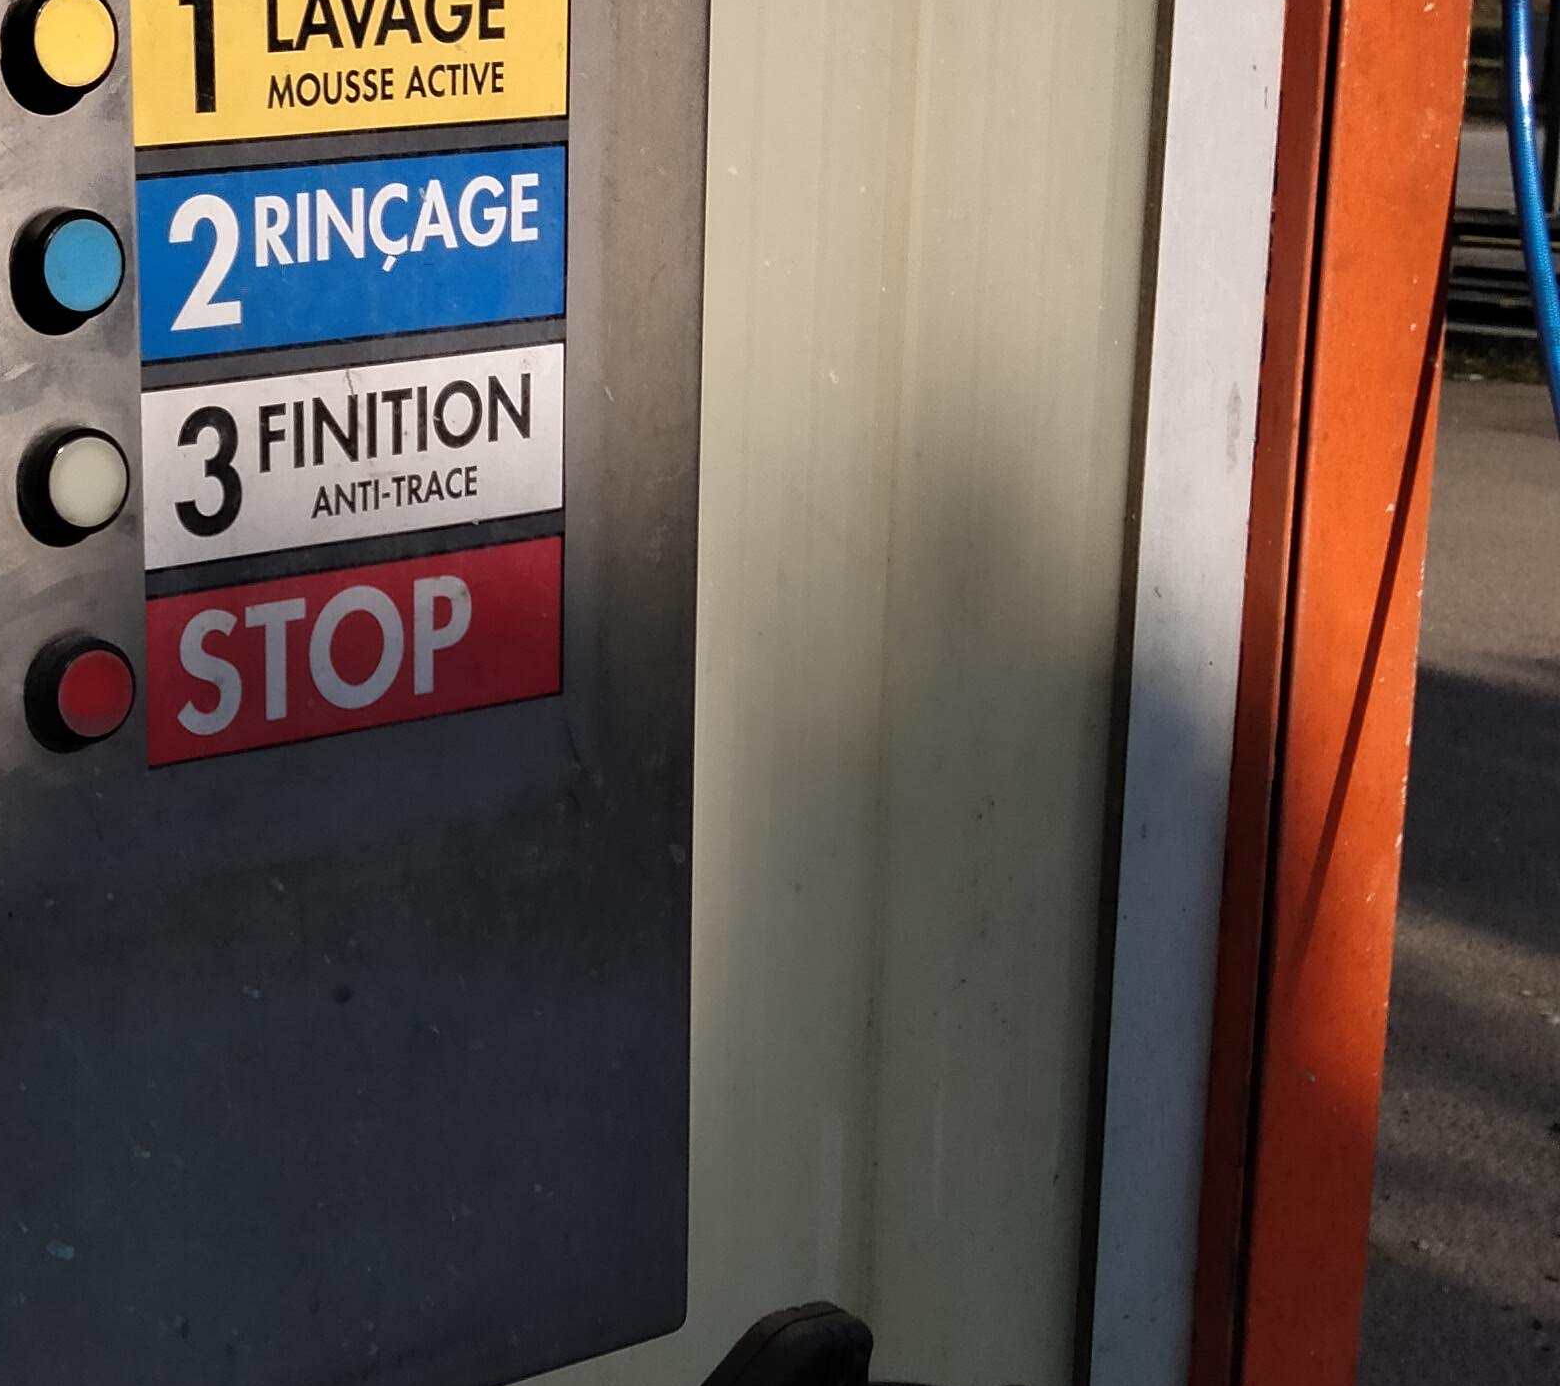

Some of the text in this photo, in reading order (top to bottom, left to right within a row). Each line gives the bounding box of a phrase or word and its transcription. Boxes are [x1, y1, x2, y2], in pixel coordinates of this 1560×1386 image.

[268, 62, 504, 109] MOUSSE ACTIVE
[168, 173, 539, 331] 2 RINÇAGE
[175, 373, 530, 537] 3 FINITION
[311, 466, 477, 519] ANTI-TRACE
[178, 576, 472, 735] STOP
